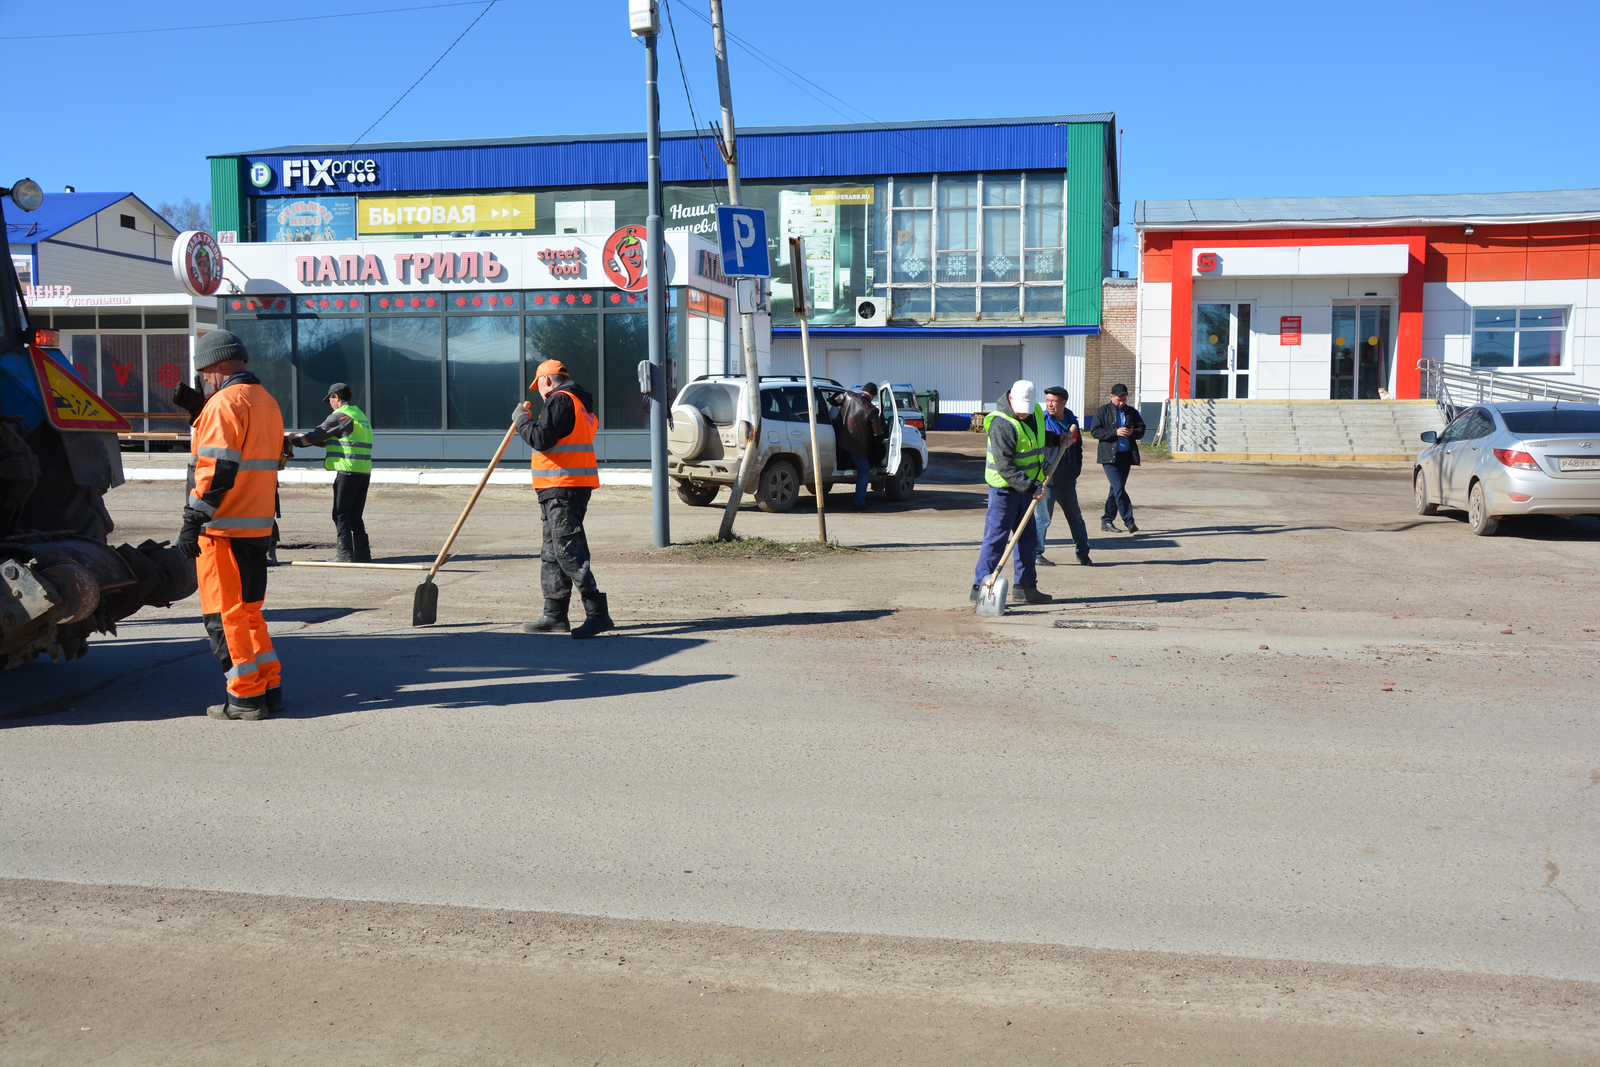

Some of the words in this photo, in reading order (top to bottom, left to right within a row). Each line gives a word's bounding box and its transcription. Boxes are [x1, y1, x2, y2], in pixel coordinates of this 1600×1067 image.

[277, 201, 334, 224] СЕДЬМОЕ
[368, 205, 476, 226] БЫТОВАЯ
[670, 202, 723, 219] Нашл
[289, 216, 322, 226] НЕБО
[187, 234, 203, 254] ПАПА
[203, 234, 220, 259] ГРИЛЬ
[537, 247, 580, 260] street
[295, 254, 381, 281] ПАПА
[393, 251, 501, 280] ГРИЛЬ
[548, 261, 579, 275] food
[26, 285, 72, 301] ЦЕНТР
[64, 297, 131, 308] тукталышы
